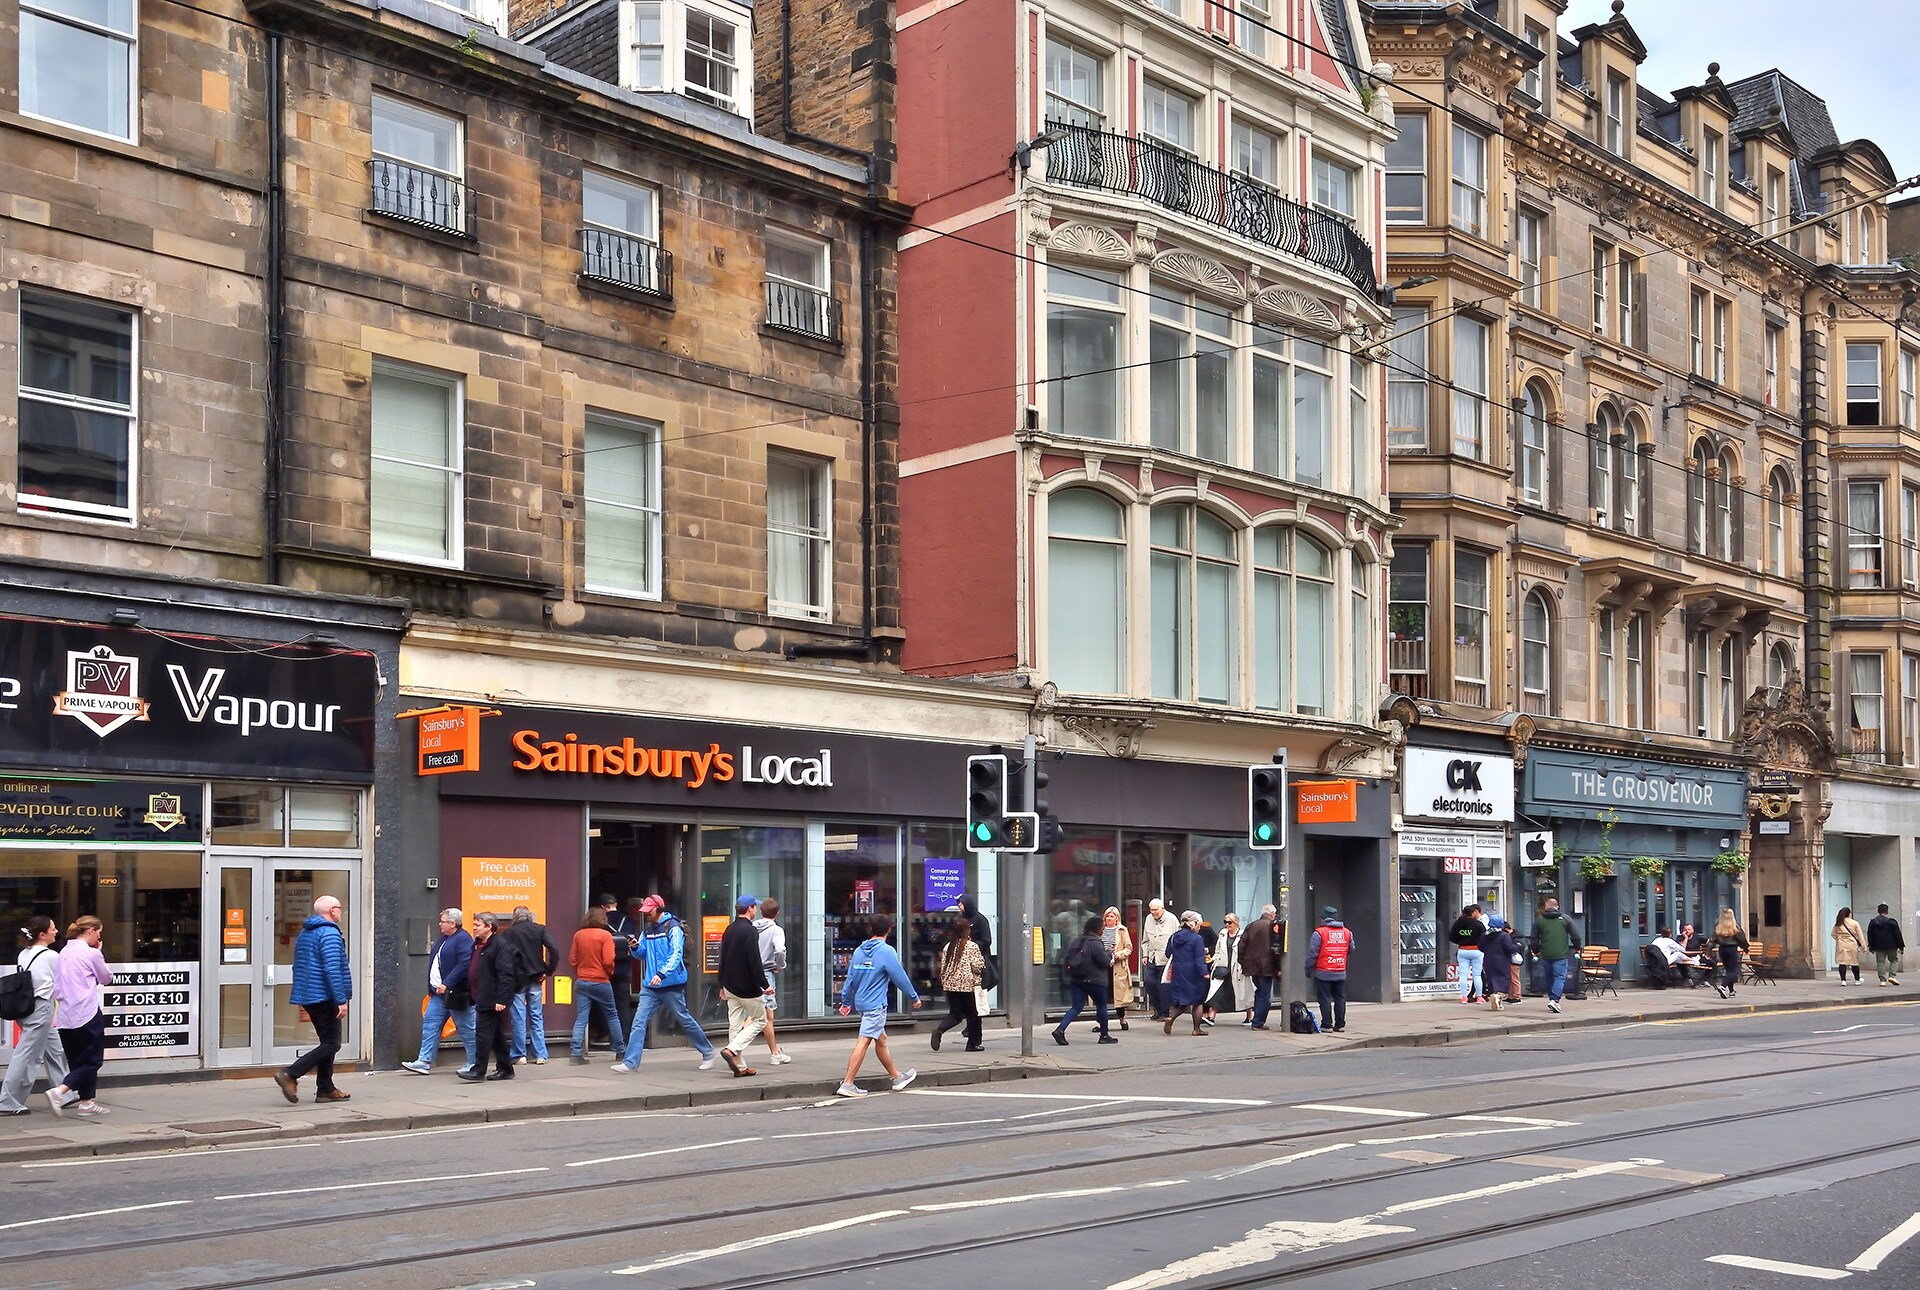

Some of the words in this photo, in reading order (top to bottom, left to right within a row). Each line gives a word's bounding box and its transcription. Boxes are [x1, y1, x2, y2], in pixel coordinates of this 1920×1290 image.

[77, 661, 129, 692] PV
[63, 696, 96, 708] PRIME
[98, 699, 141, 711] VAPOUR
[166, 663, 341, 736] Vapour
[422, 715, 465, 732] Sainsbury's
[422, 733, 442, 749] Local
[428, 755, 443, 766] Free
[442, 752, 459, 764] cash
[512, 729, 735, 788] Sainsbury's
[742, 745, 834, 787] Local
[1446, 759, 1482, 791] CK
[4, 782, 38, 792] online
[40, 784, 51, 794] at
[1571, 771, 1607, 797] THE
[1612, 776, 1713, 806] GROSVENOR
[1301, 792, 1349, 803] Sainsbury's
[1301, 803, 1323, 813] Local
[1432, 796, 1493, 815] electronics
[480, 861, 503, 873] Free
[505, 861, 529, 873] cash
[1445, 857, 1472, 872] SALE
[472, 875, 536, 888] withdrawals
[478, 893, 513, 902] Sainsbury's
[514, 893, 530, 901] Bank
[112, 974, 132, 984] MIX
[136, 974, 145, 983] &
[147, 973, 183, 983] MATCH
[112, 994, 121, 1006] 2
[125, 993, 156, 1005] FOR
[159, 992, 184, 1004] £10
[112, 1015, 121, 1027] 5
[124, 1014, 155, 1026] FOR
[159, 1013, 183, 1025] £20
